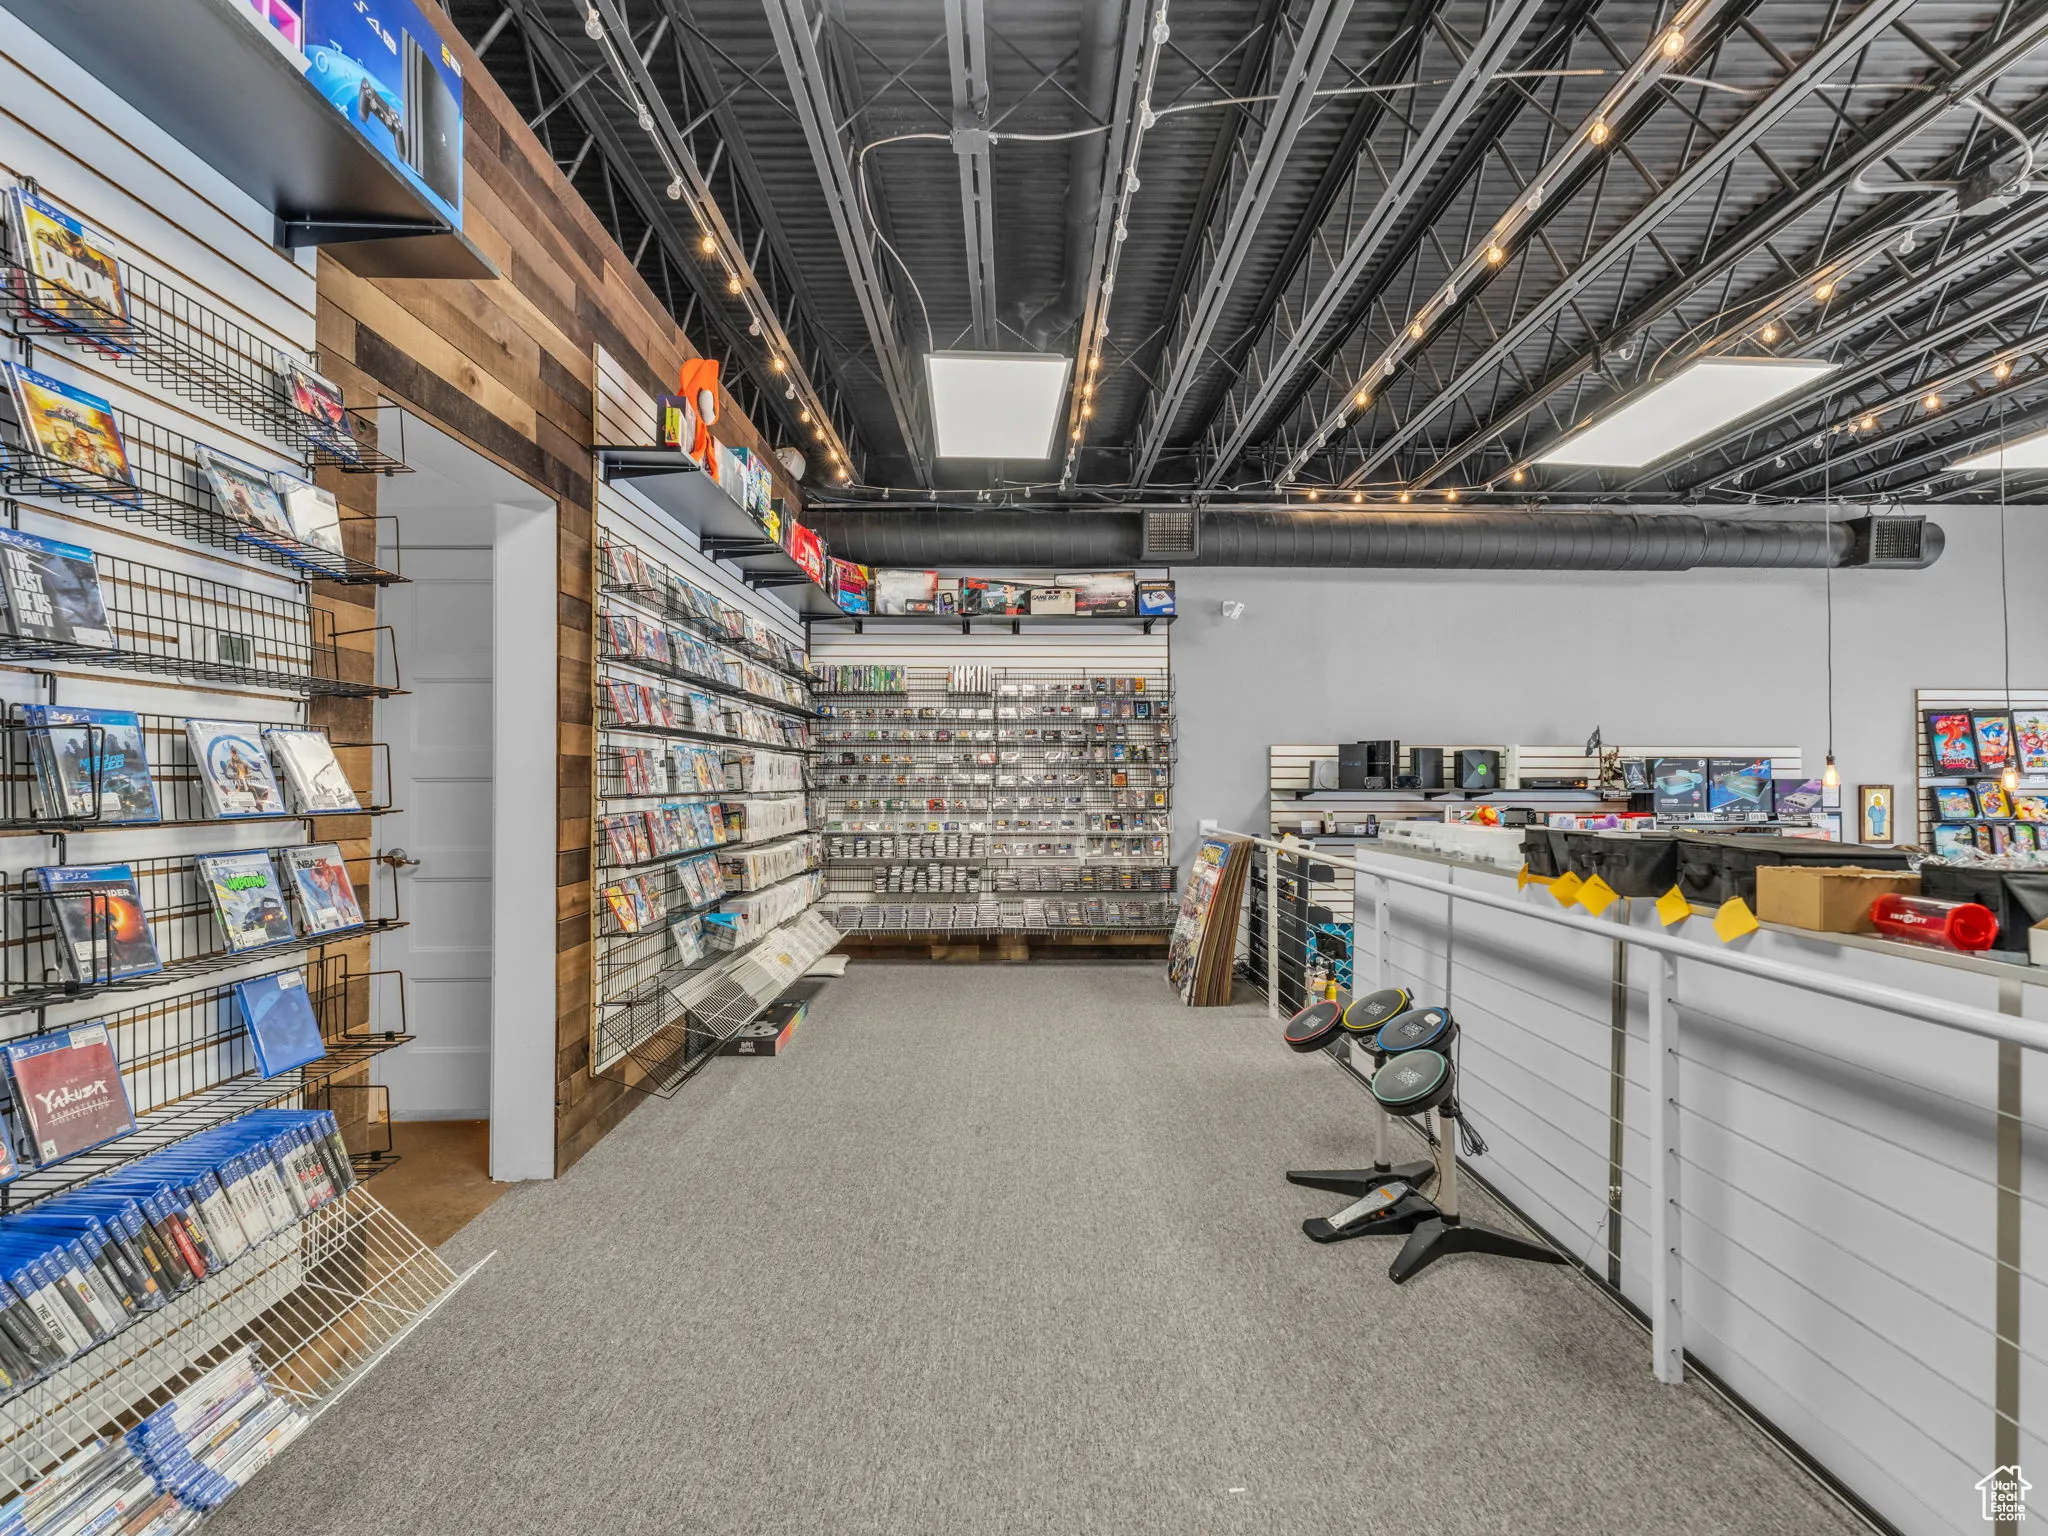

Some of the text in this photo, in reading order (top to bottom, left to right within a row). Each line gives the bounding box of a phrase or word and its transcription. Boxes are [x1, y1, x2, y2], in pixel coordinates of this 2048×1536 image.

[39, 206, 67, 226] PS4
[38, 240, 119, 305] DOOM
[33, 376, 62, 393] PS4
[5, 549, 33, 573] THE
[9, 568, 45, 593] LAST
[14, 588, 34, 610] OF
[31, 591, 54, 614] US
[19, 609, 45, 626] PART
[65, 872, 89, 880] PS4
[30, 1041, 57, 1054] PS4
[66, 1077, 78, 1085] THE
[319, 1148, 340, 1178] OUTRIDERS
[35, 1303, 51, 1320] THE
[251, 1454, 269, 1470] UFC
